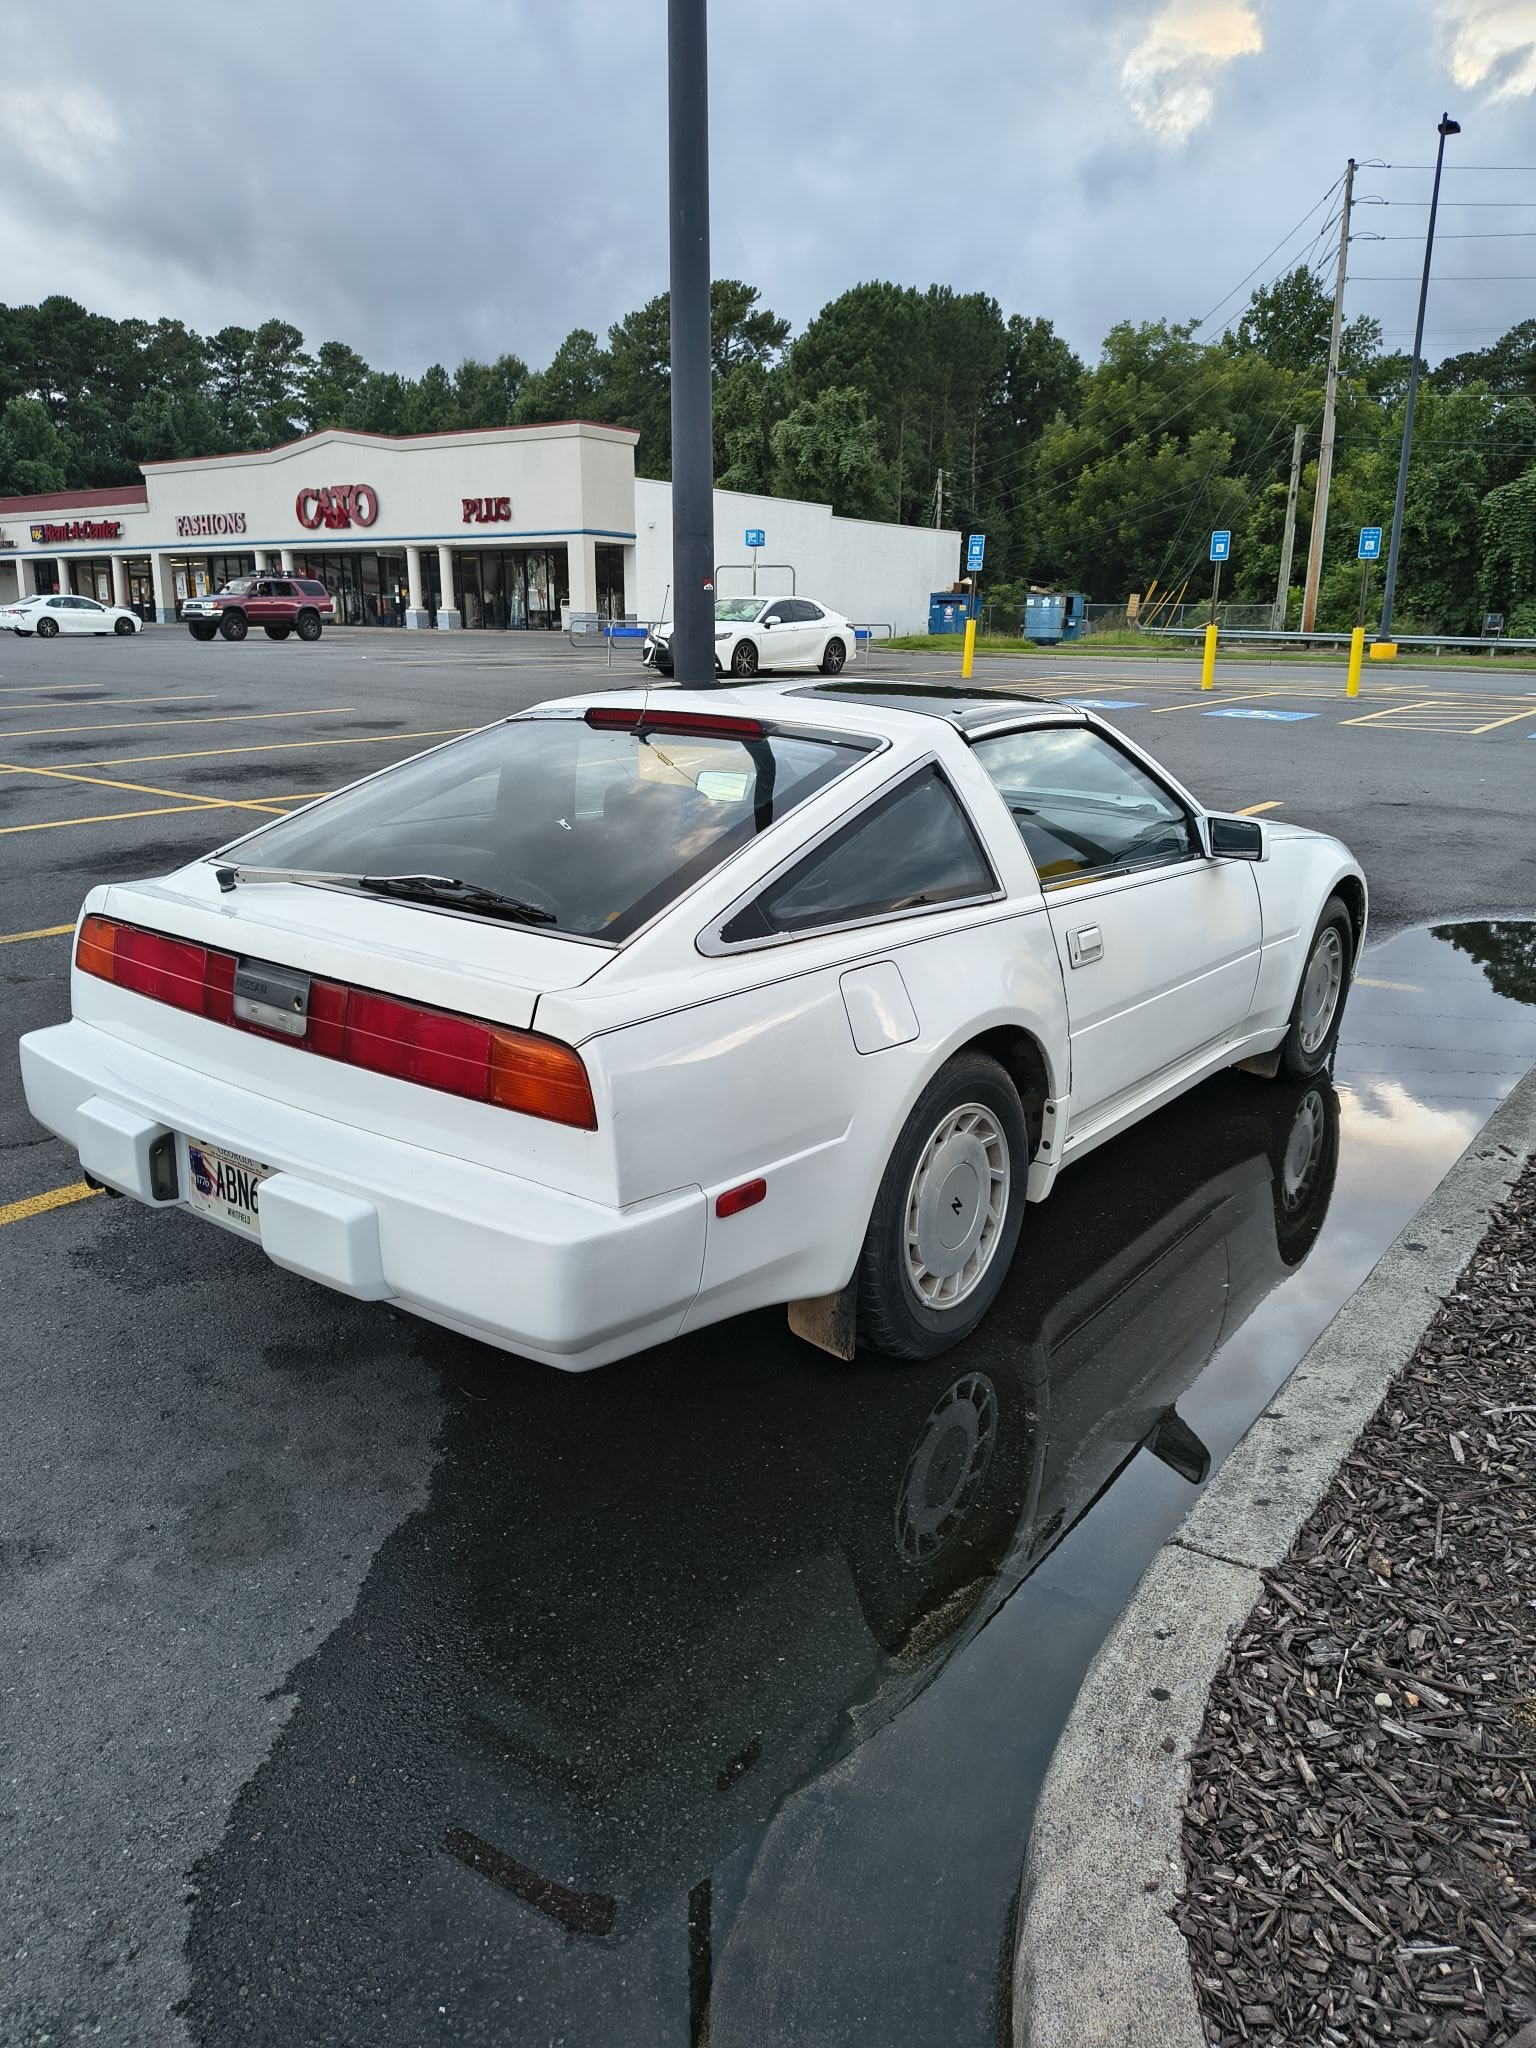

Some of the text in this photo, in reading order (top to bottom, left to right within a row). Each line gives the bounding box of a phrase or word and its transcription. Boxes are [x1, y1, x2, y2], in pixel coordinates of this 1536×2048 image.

[295, 483, 378, 530] CATO
[461, 496, 512, 524] PLUS
[44, 520, 120, 542] Rent-A-Center
[175, 512, 247, 536] FASHIONS
[236, 977, 268, 995] NISSAN
[196, 1175, 210, 1187] 1776
[226, 1206, 251, 1225] WHITFIELD
